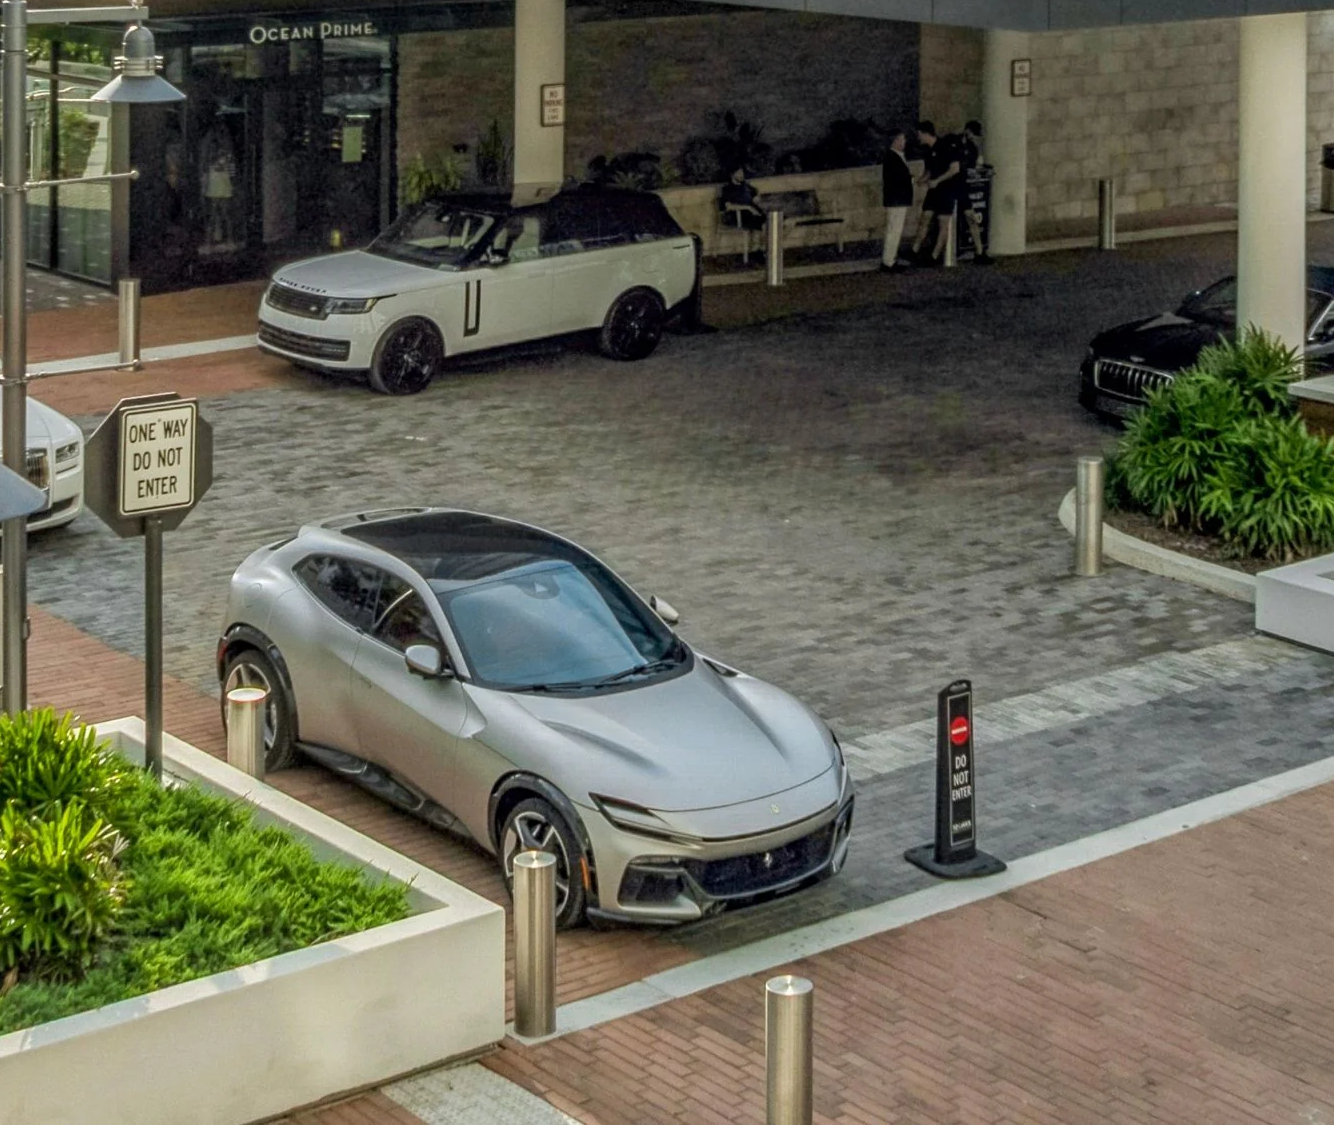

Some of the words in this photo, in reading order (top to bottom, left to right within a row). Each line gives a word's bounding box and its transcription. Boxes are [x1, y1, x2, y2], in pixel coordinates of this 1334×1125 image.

[249, 26, 314, 44] OCEAN
[320, 22, 374, 39] PRIME
[129, 423, 156, 444] ONE
[163, 418, 188, 439] WAY
[133, 451, 151, 471] DO
[157, 447, 183, 468] NOT
[137, 475, 178, 498] ENTER
[955, 754, 967, 769] DO
[953, 770, 969, 787] NOT
[952, 785, 972, 801] ENTER
